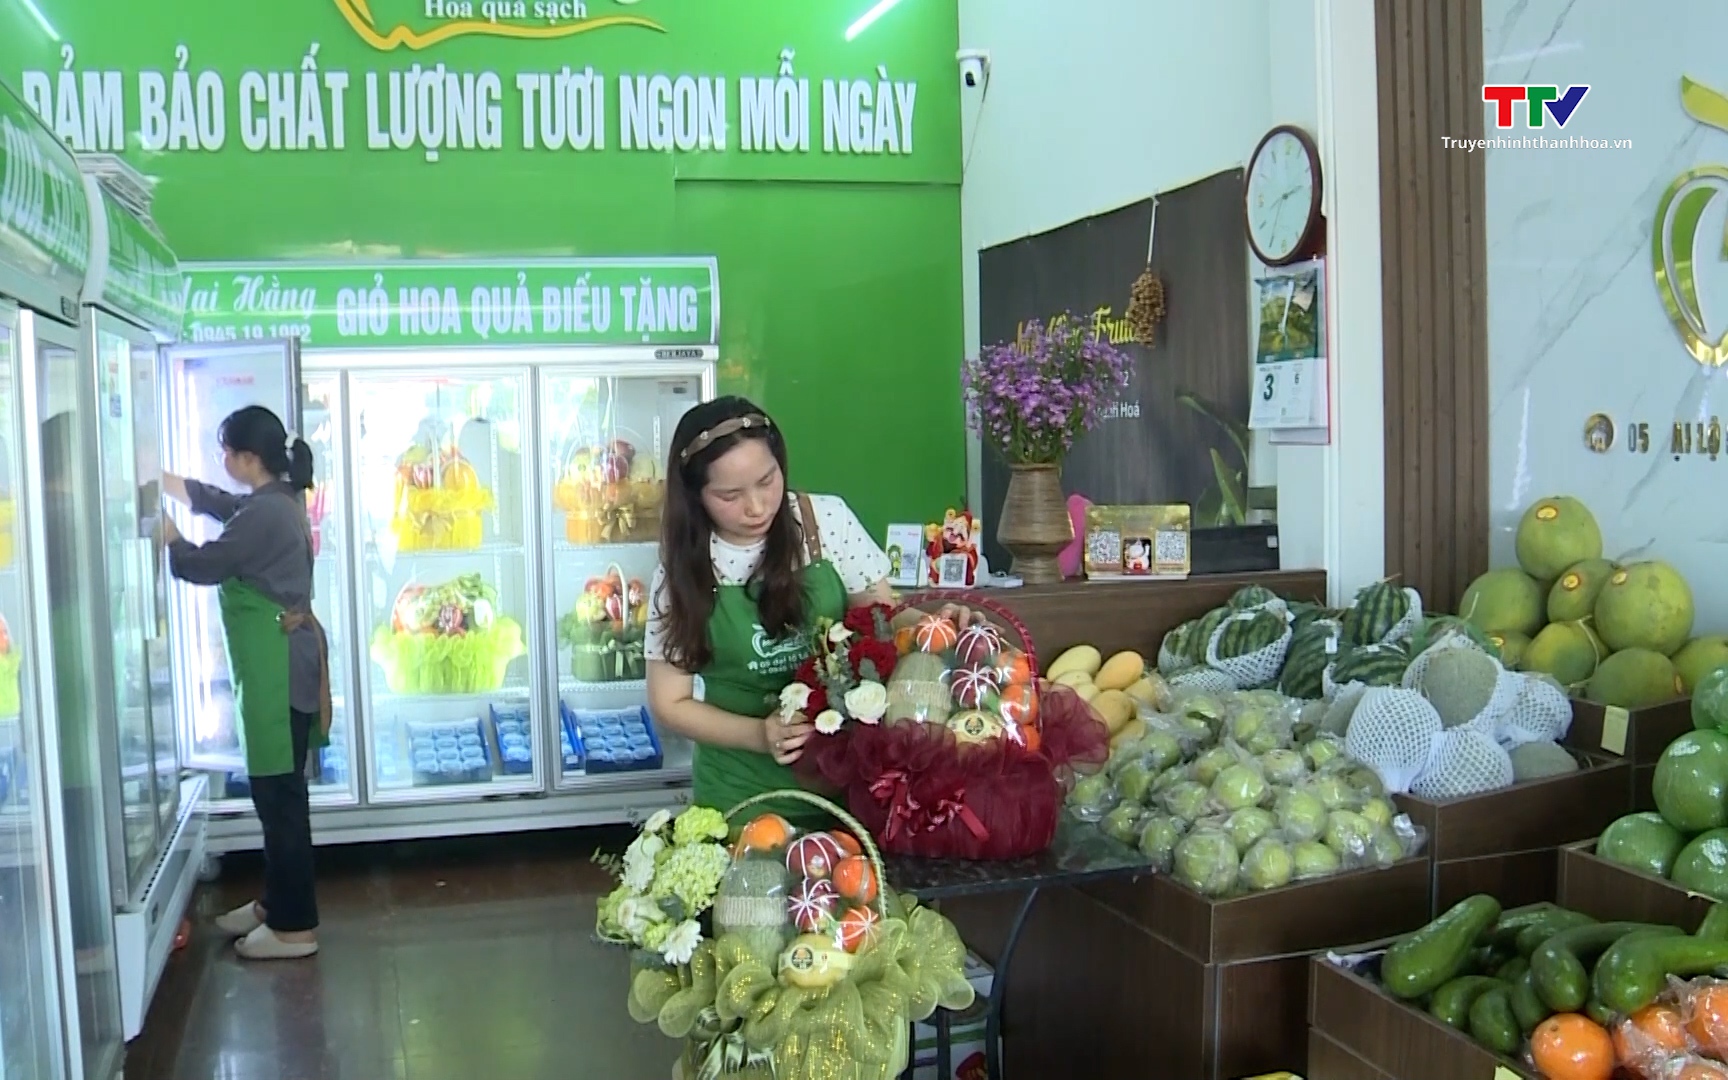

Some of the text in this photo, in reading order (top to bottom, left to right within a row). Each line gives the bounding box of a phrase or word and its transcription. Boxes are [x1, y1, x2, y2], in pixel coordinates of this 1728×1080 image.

[424, 0, 474, 18] Hoa
[534, 0, 588, 25] sạch
[139, 44, 225, 151] BẢO
[240, 42, 348, 150] CHẤT
[366, 63, 502, 162] LƯỢNG
[516, 65, 605, 150] TƯƠI
[619, 73, 726, 151] NGON
[740, 47, 810, 152] MỖI
[823, 64, 917, 154] NGÀY
[232, 274, 317, 320] Hằng
[336, 270, 698, 342] GIỎ HOA QUẢ BIẾU TẶNG
[1263, 373, 1275, 401] 3
[1627, 422, 1650, 454] 05
